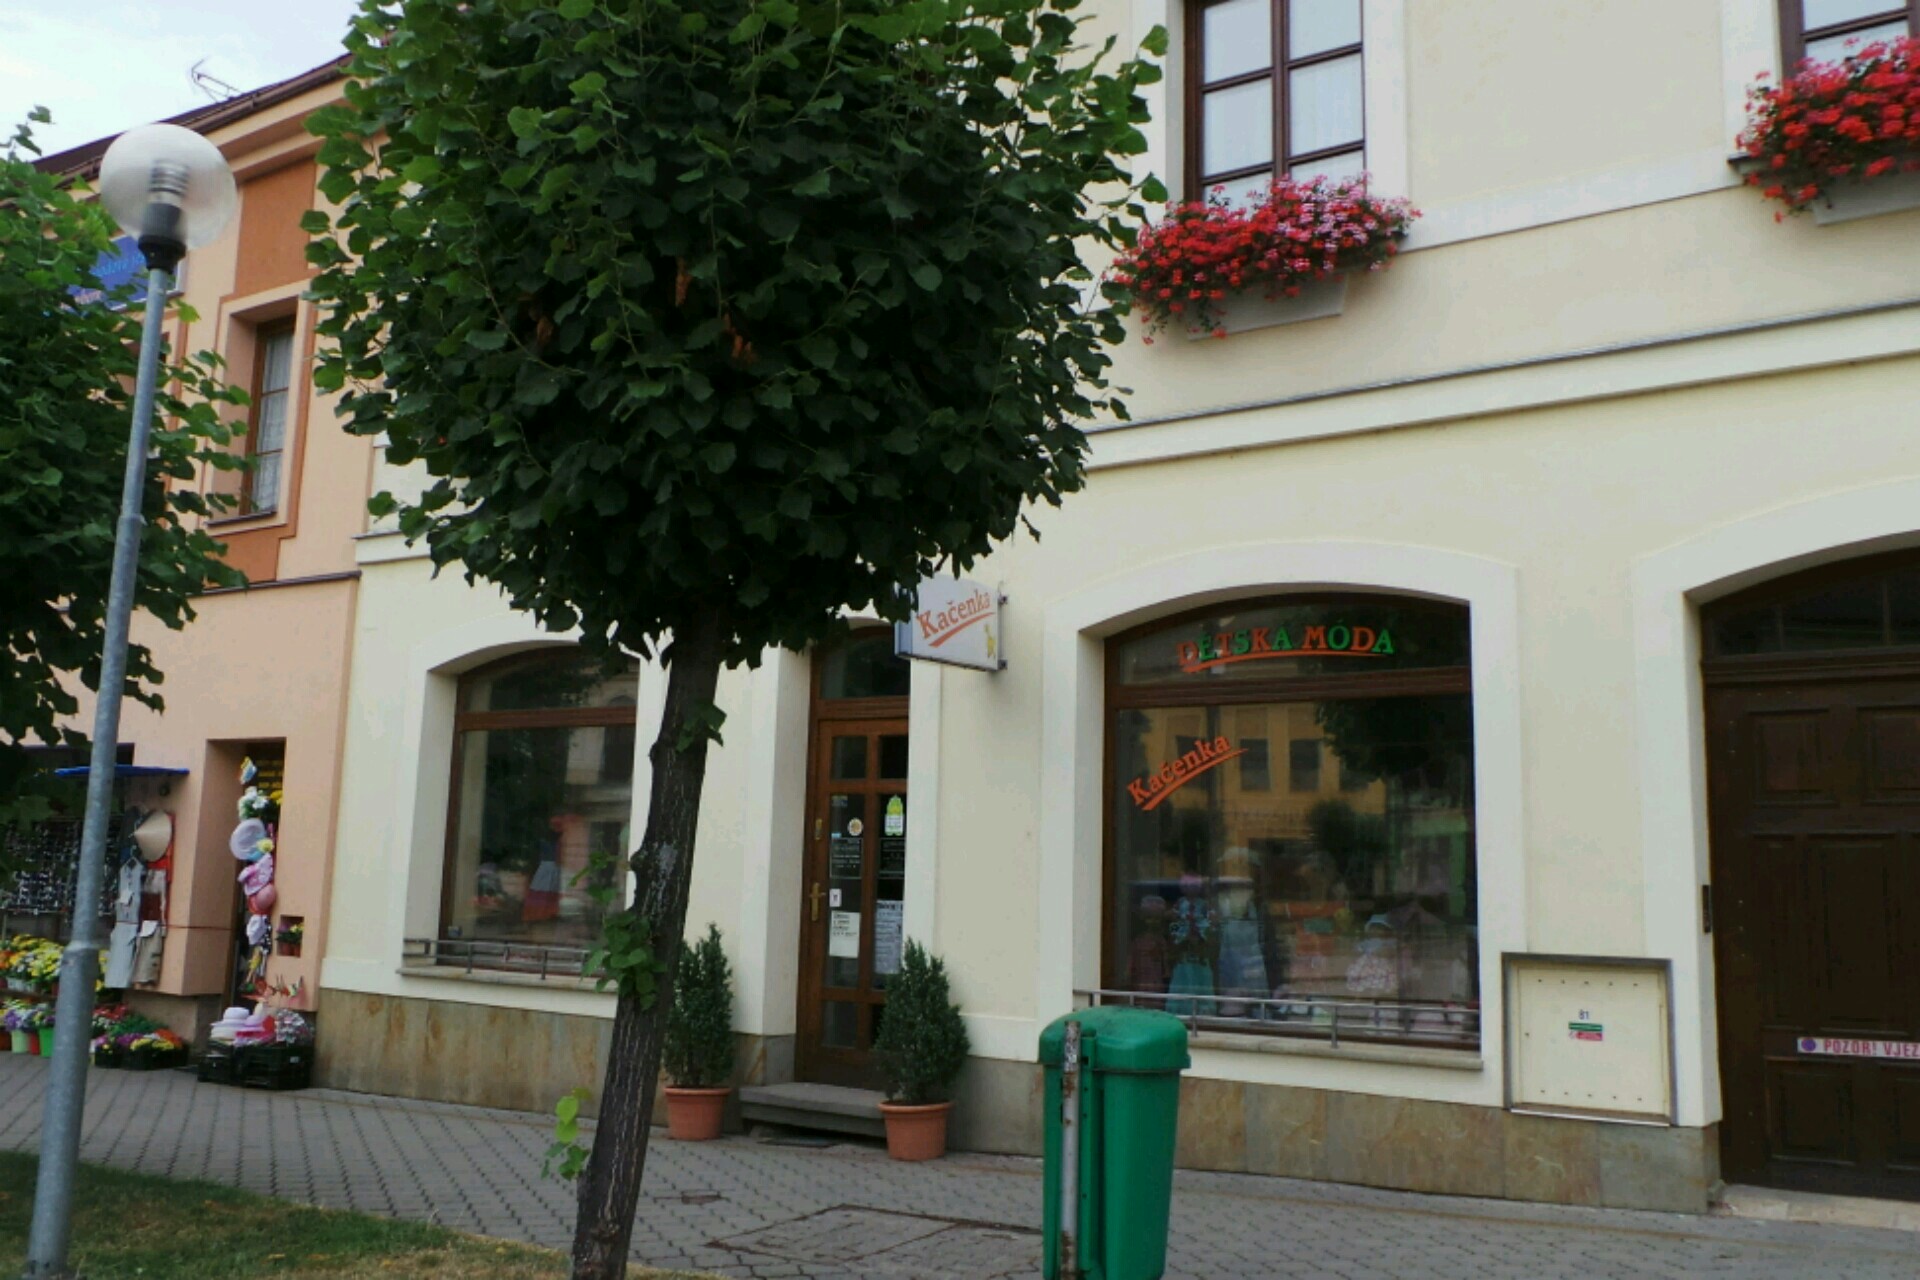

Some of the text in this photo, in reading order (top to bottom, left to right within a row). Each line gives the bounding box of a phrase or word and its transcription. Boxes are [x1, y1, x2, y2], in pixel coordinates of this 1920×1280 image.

[916, 588, 991, 639] Kačenka
[1302, 619, 1394, 654] MÓDA
[1126, 736, 1231, 805] Kačenka
[1824, 1039, 1877, 1056] POZOR!
